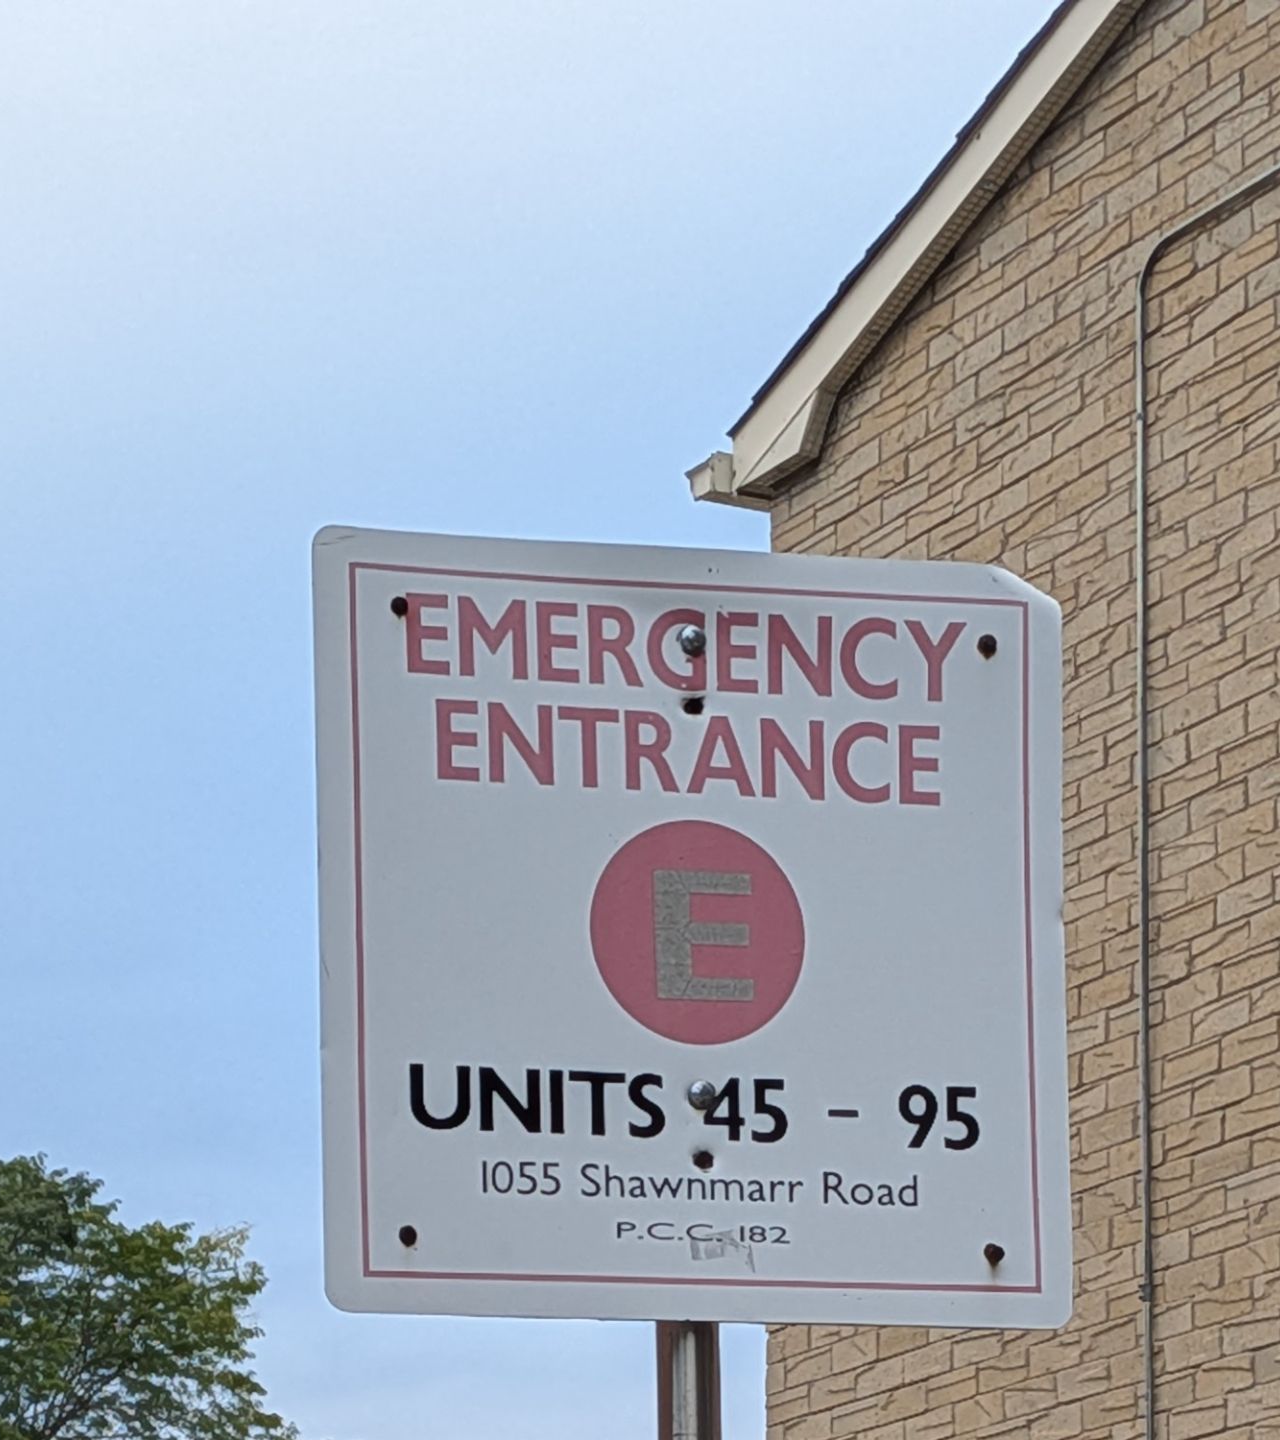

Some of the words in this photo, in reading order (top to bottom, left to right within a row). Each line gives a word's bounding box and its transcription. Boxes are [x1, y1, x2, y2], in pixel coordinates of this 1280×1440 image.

[405, 592, 967, 702] EMERGENCY
[436, 698, 941, 806] ENTRANCE
[652, 869, 755, 1001] E
[409, 1062, 666, 1139] UNITS
[703, 1078, 788, 1143] 45
[898, 1084, 980, 1150] 95
[481, 1160, 562, 1196] 1055
[580, 1163, 804, 1203] Shawnmarr
[822, 1170, 919, 1208] Road
[616, 1221, 723, 1243] P.C.C.
[739, 1225, 791, 1245] 182
